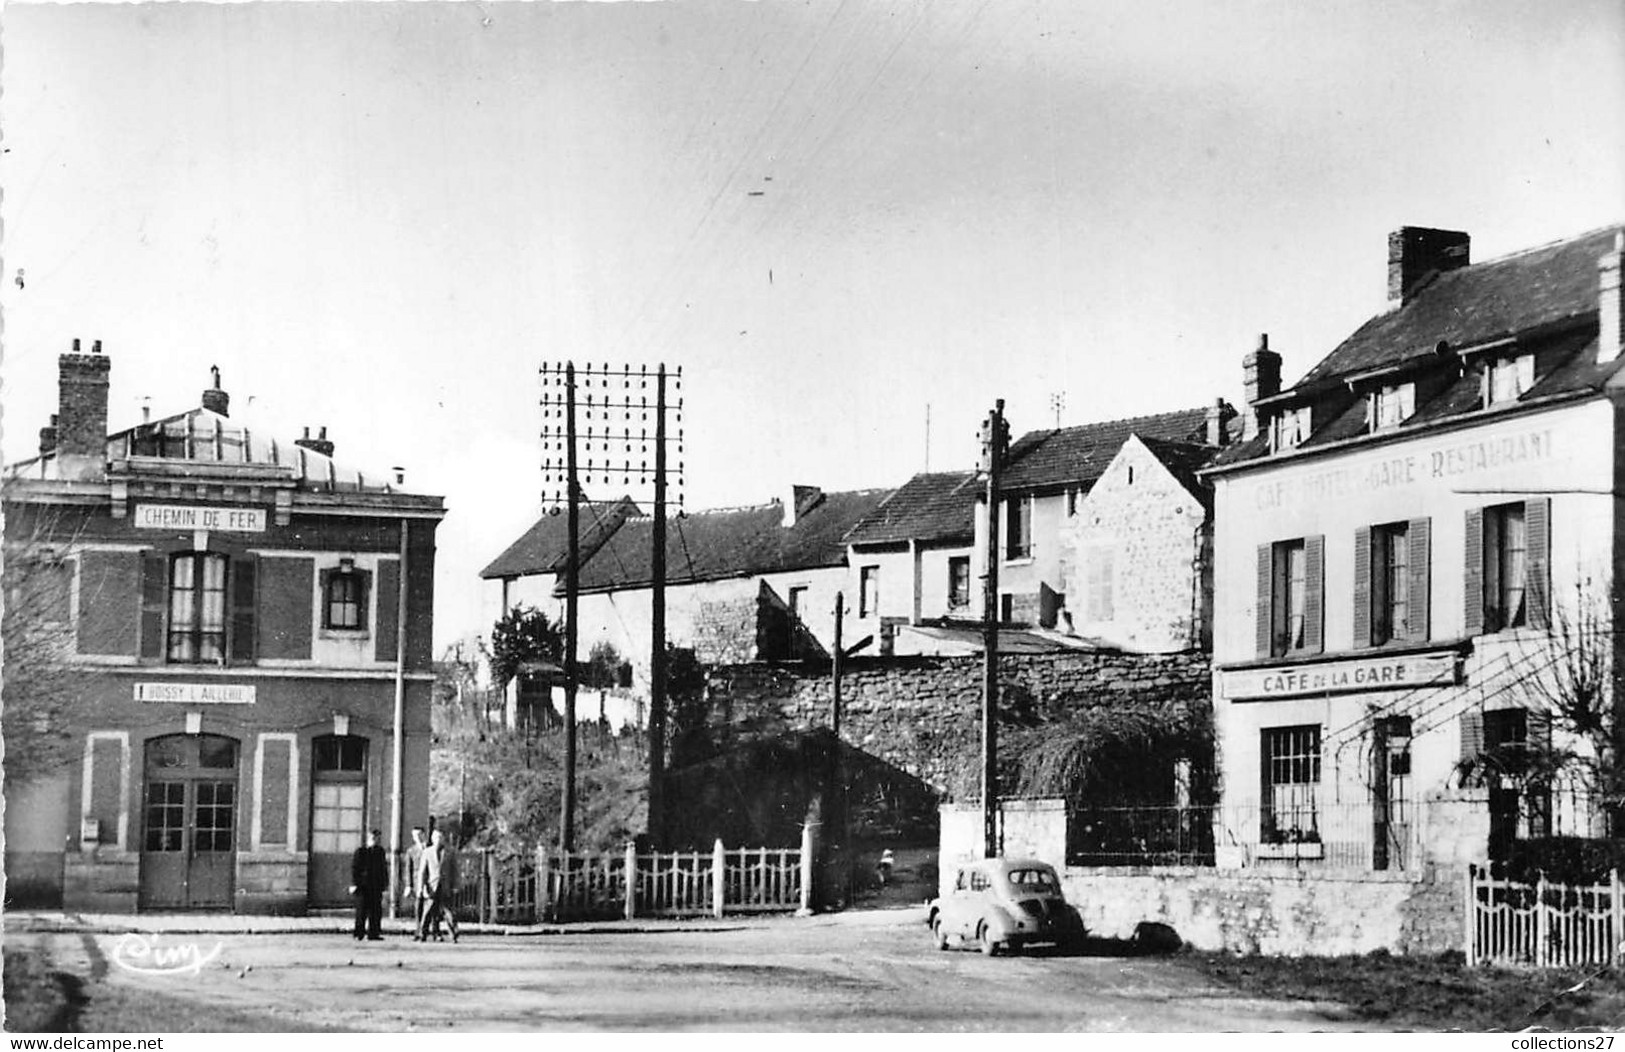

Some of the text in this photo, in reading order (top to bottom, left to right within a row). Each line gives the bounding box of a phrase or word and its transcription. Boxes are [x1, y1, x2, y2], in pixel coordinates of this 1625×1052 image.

[1369, 455, 1415, 491] GARE
[1431, 428, 1551, 478] RESTAURANT
[145, 508, 257, 529] CHEMIN DE FER
[1263, 674, 1309, 693] CAFE
[1331, 671, 1348, 685] LA
[1354, 664, 1405, 684] GARE
